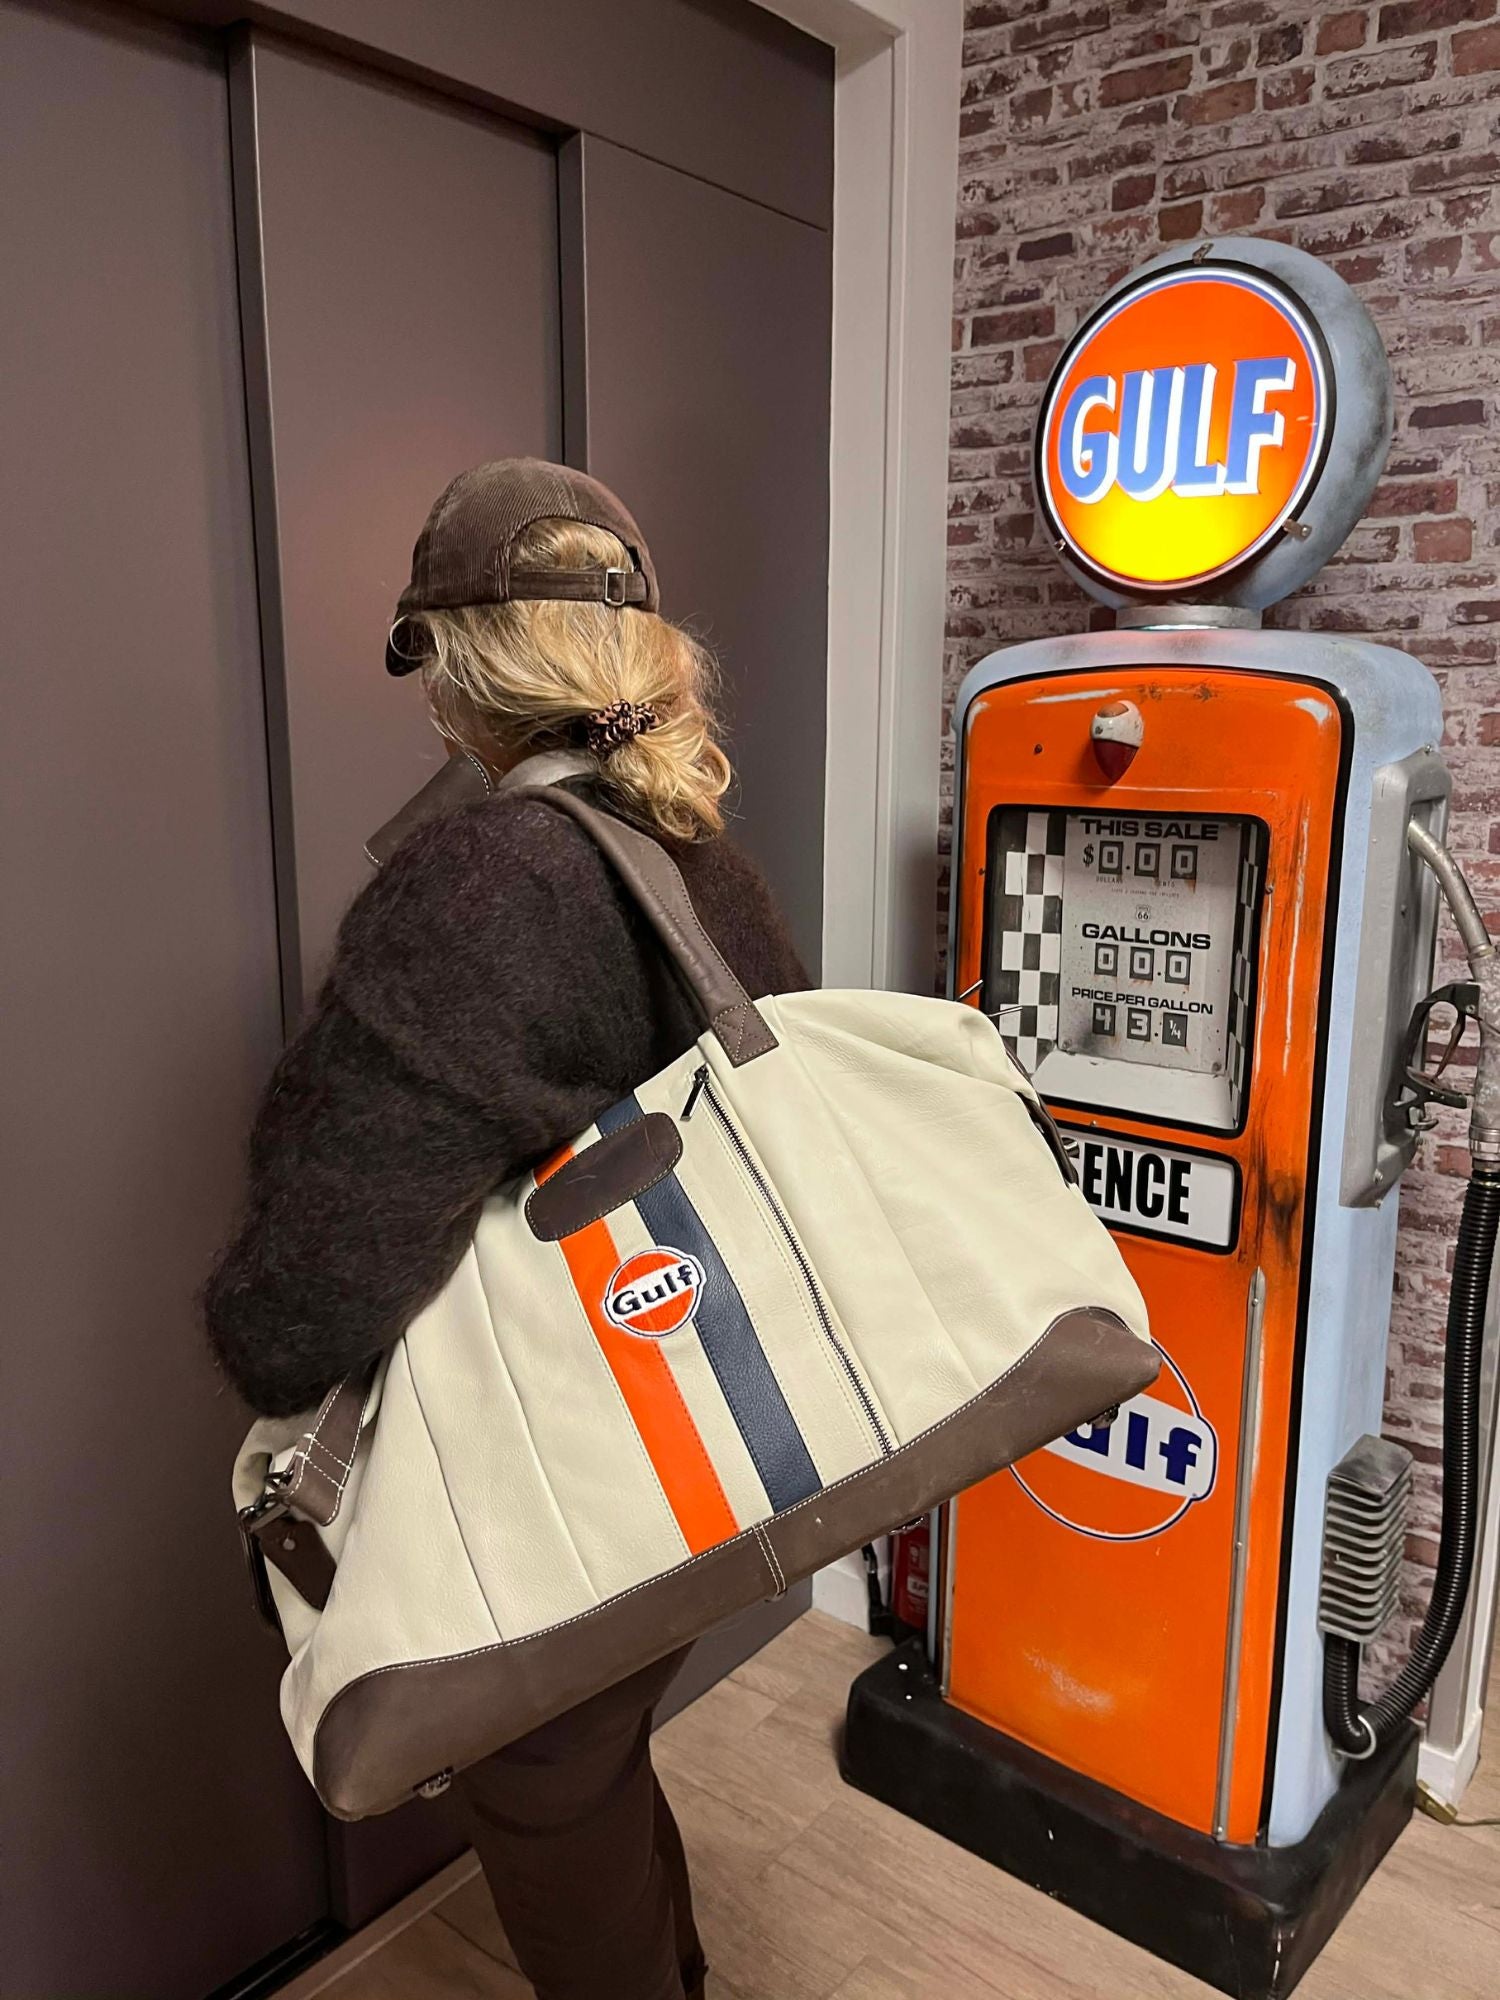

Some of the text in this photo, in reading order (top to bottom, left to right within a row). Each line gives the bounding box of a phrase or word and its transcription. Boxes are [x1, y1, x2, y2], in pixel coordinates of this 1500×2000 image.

[1059, 356, 1296, 504] GULF
[1080, 818, 1219, 841] THIS SALE
[1137, 911, 1149, 920] 66
[1082, 923, 1211, 950] GALLONS
[1072, 987, 1213, 1015] PRICE PER GALLON
[612, 1264, 692, 1315] Gulf
[1064, 1411, 1202, 1485] ulf
